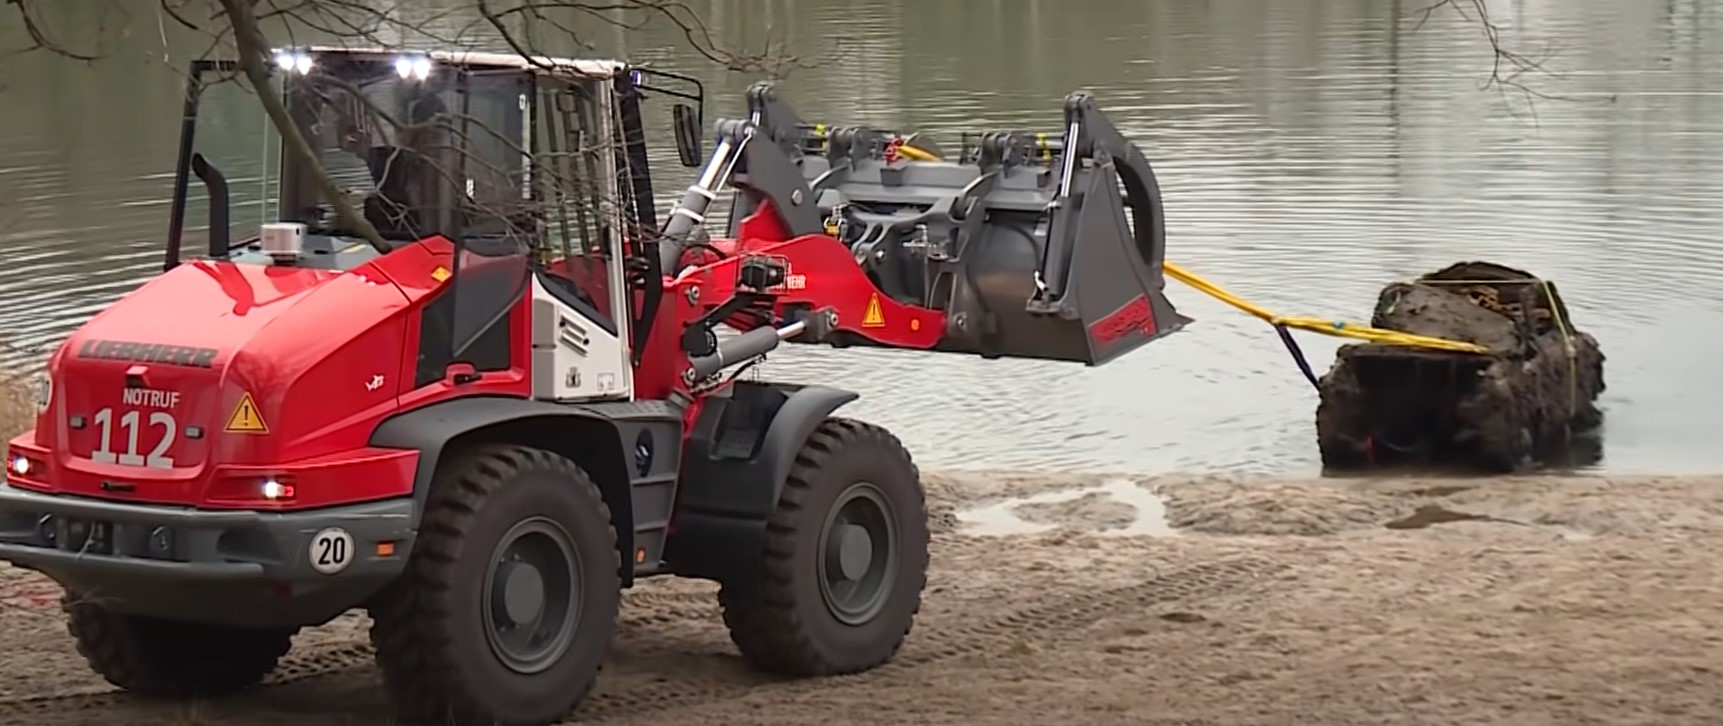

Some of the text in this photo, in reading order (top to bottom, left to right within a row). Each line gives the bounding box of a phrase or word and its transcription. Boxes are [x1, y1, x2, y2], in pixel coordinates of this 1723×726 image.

[79, 339, 218, 368] LIEBHERR
[123, 387, 180, 409] NOTRUF
[92, 407, 177, 469] 112
[318, 536, 345, 565] 20
